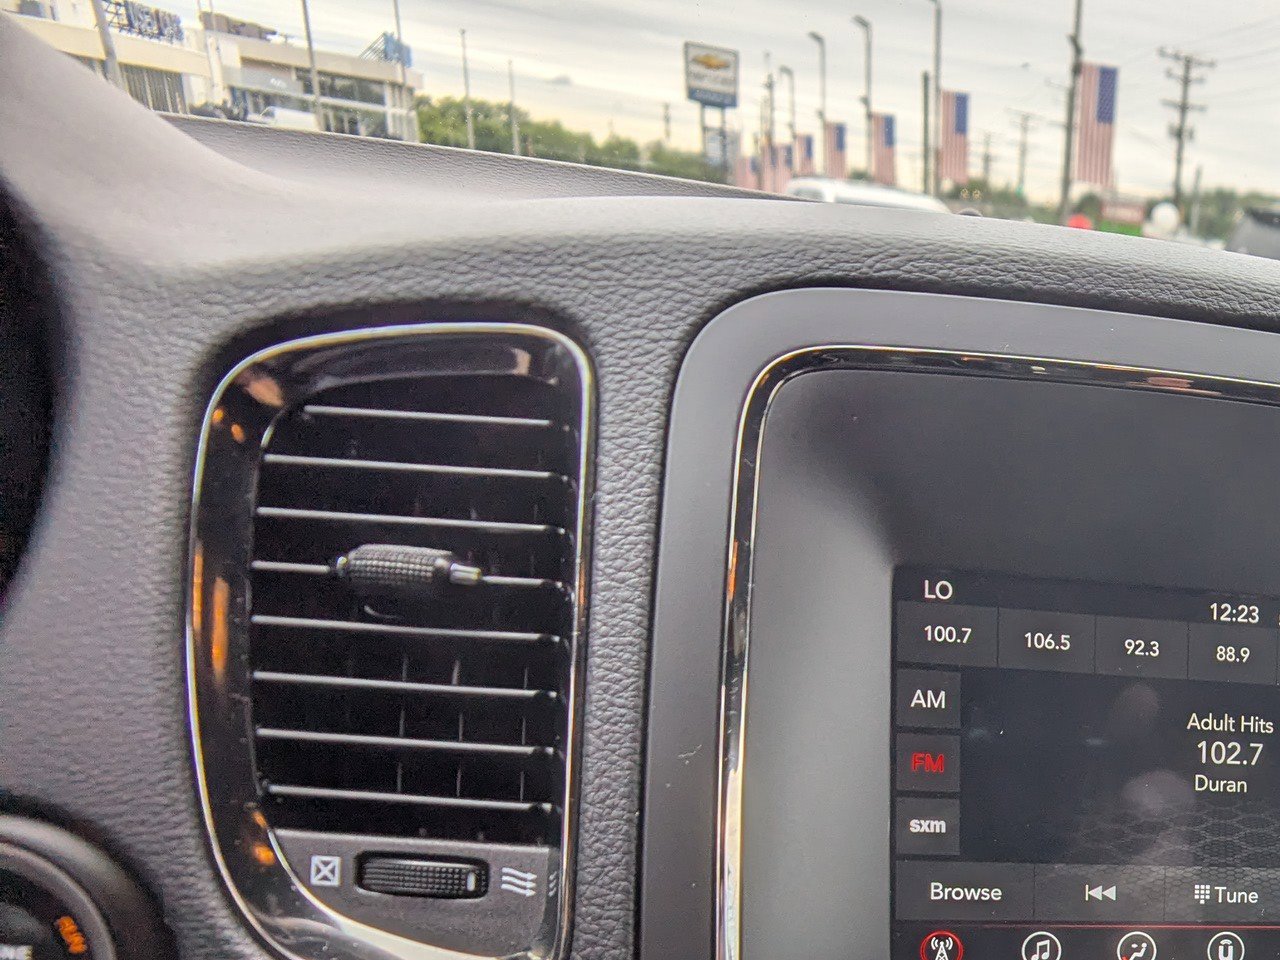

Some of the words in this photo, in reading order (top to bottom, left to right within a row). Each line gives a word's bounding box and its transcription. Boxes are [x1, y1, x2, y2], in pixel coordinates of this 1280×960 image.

[925, 580, 952, 599] LO
[1211, 603, 1259, 623] 12:23
[925, 626, 971, 643] 100.7
[1025, 633, 1070, 650] 106.5
[1125, 639, 1159, 656] 92.3
[1217, 646, 1249, 662] 88.9
[911, 690, 945, 708] AM
[1187, 713, 1235, 731] Adult
[1241, 716, 1273, 733] Hits
[1198, 741, 1263, 765] 102.7
[912, 753, 944, 772] FM
[1195, 775, 1247, 792] Duran
[910, 819, 945, 833] sxm
[931, 882, 1002, 900] Browse
[1215, 887, 1258, 903] Tune
